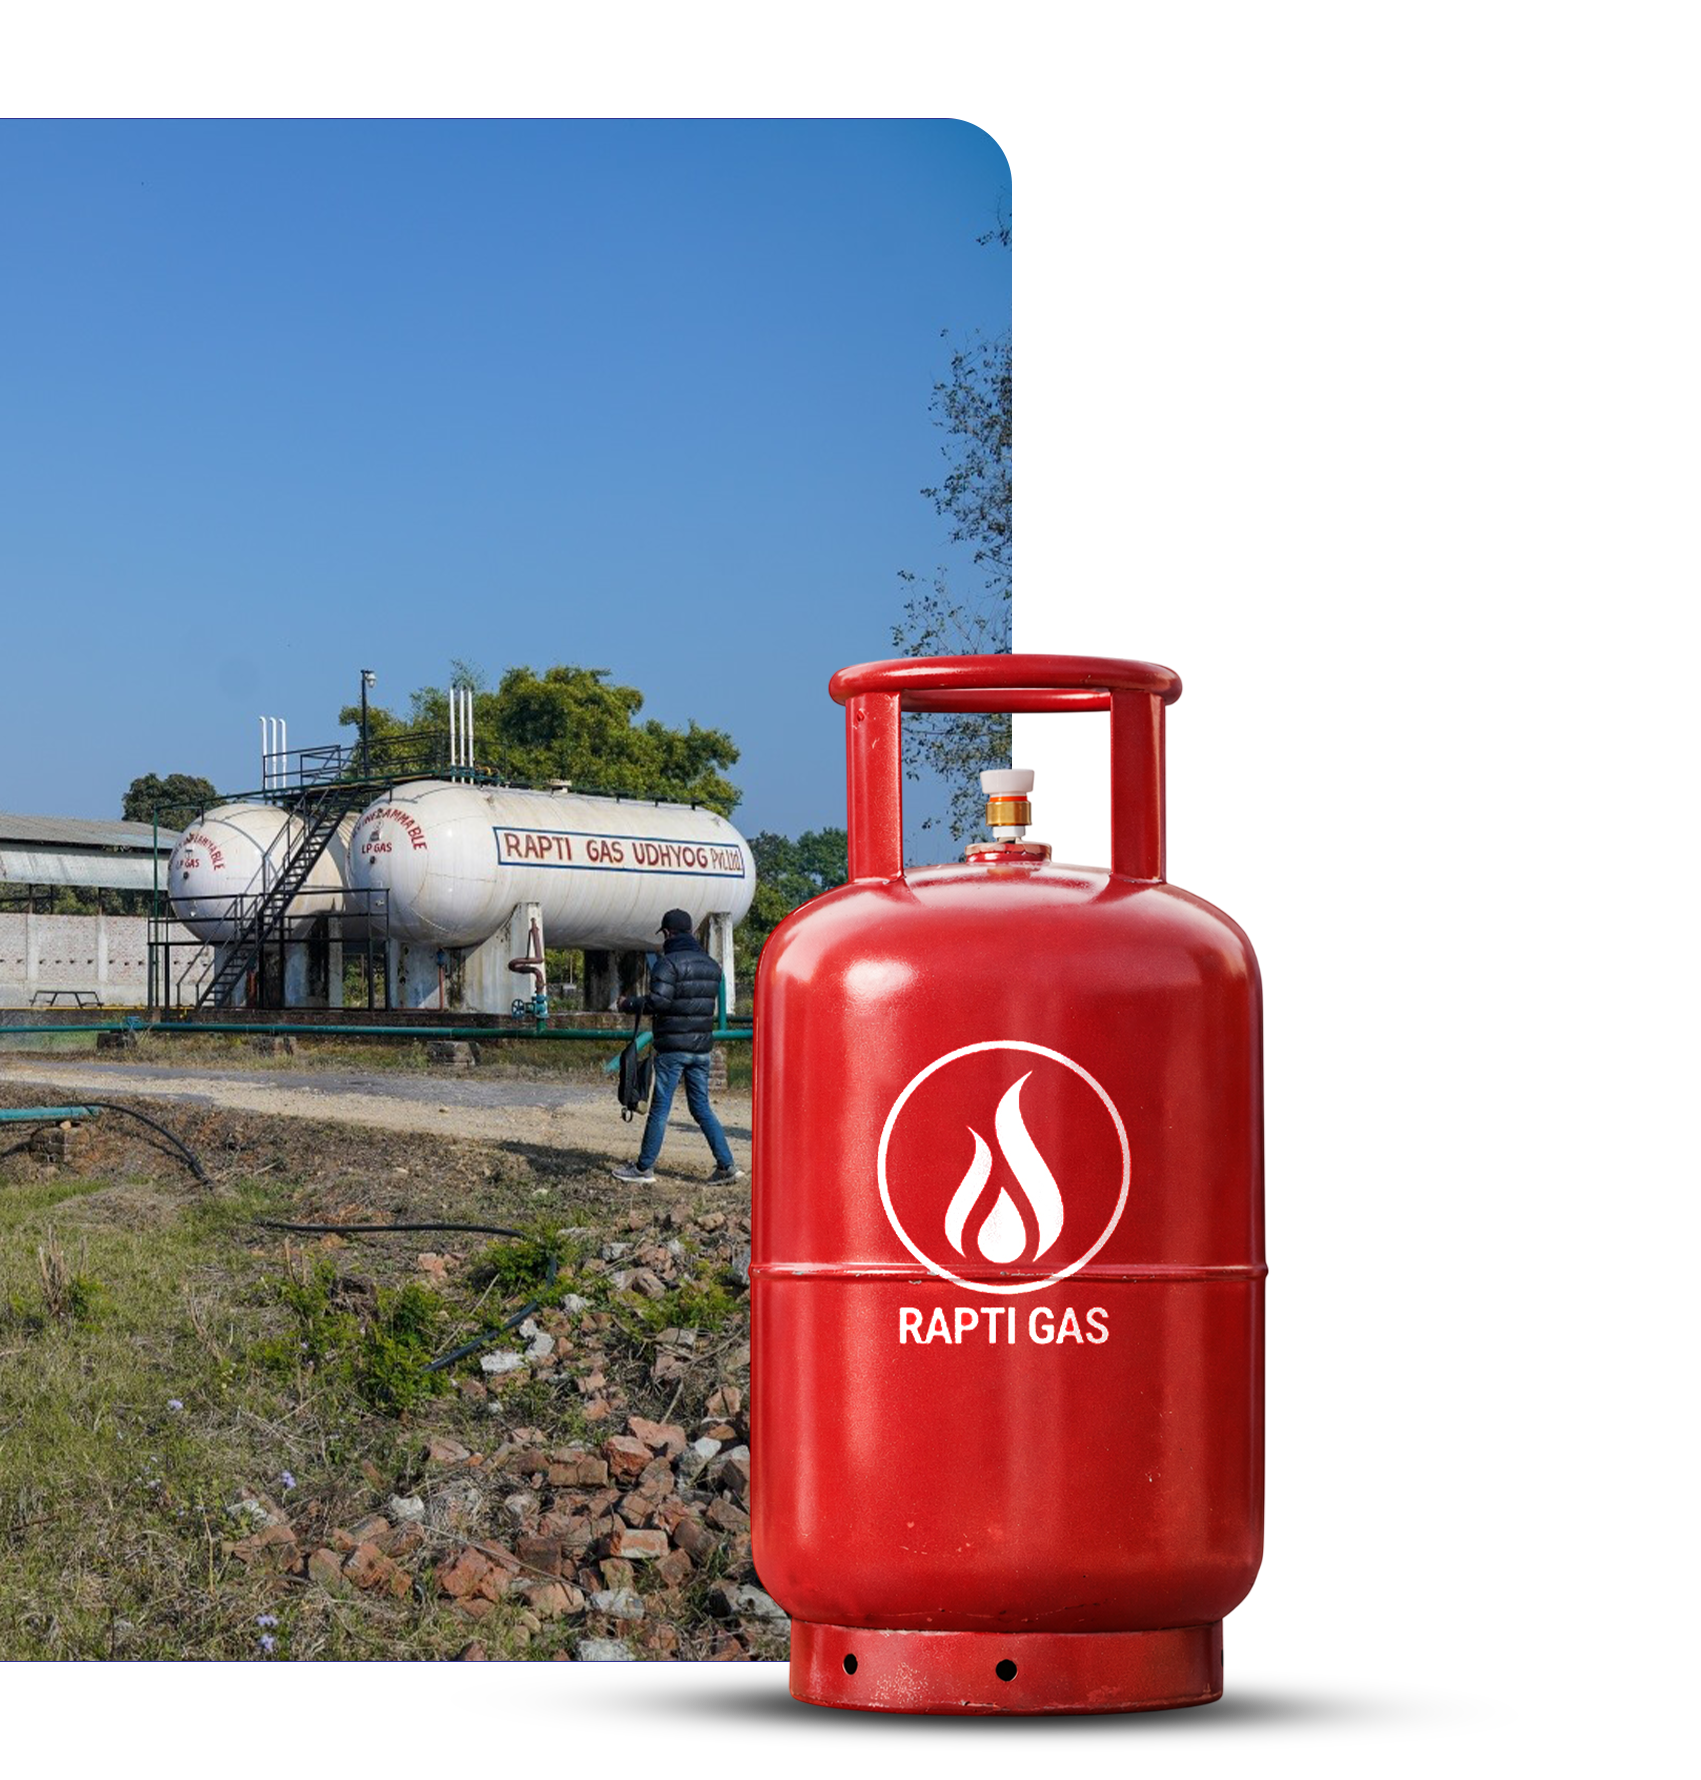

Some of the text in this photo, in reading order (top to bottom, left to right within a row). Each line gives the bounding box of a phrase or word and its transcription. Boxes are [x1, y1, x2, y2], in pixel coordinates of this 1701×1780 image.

[361, 842, 392, 854] LP GAS
[503, 832, 572, 861] RAPTI
[586, 839, 624, 864] GAS
[632, 842, 708, 869] UDHYOG
[184, 858, 200, 868] GAS
[899, 1306, 1110, 1344] RAPTI GAS
